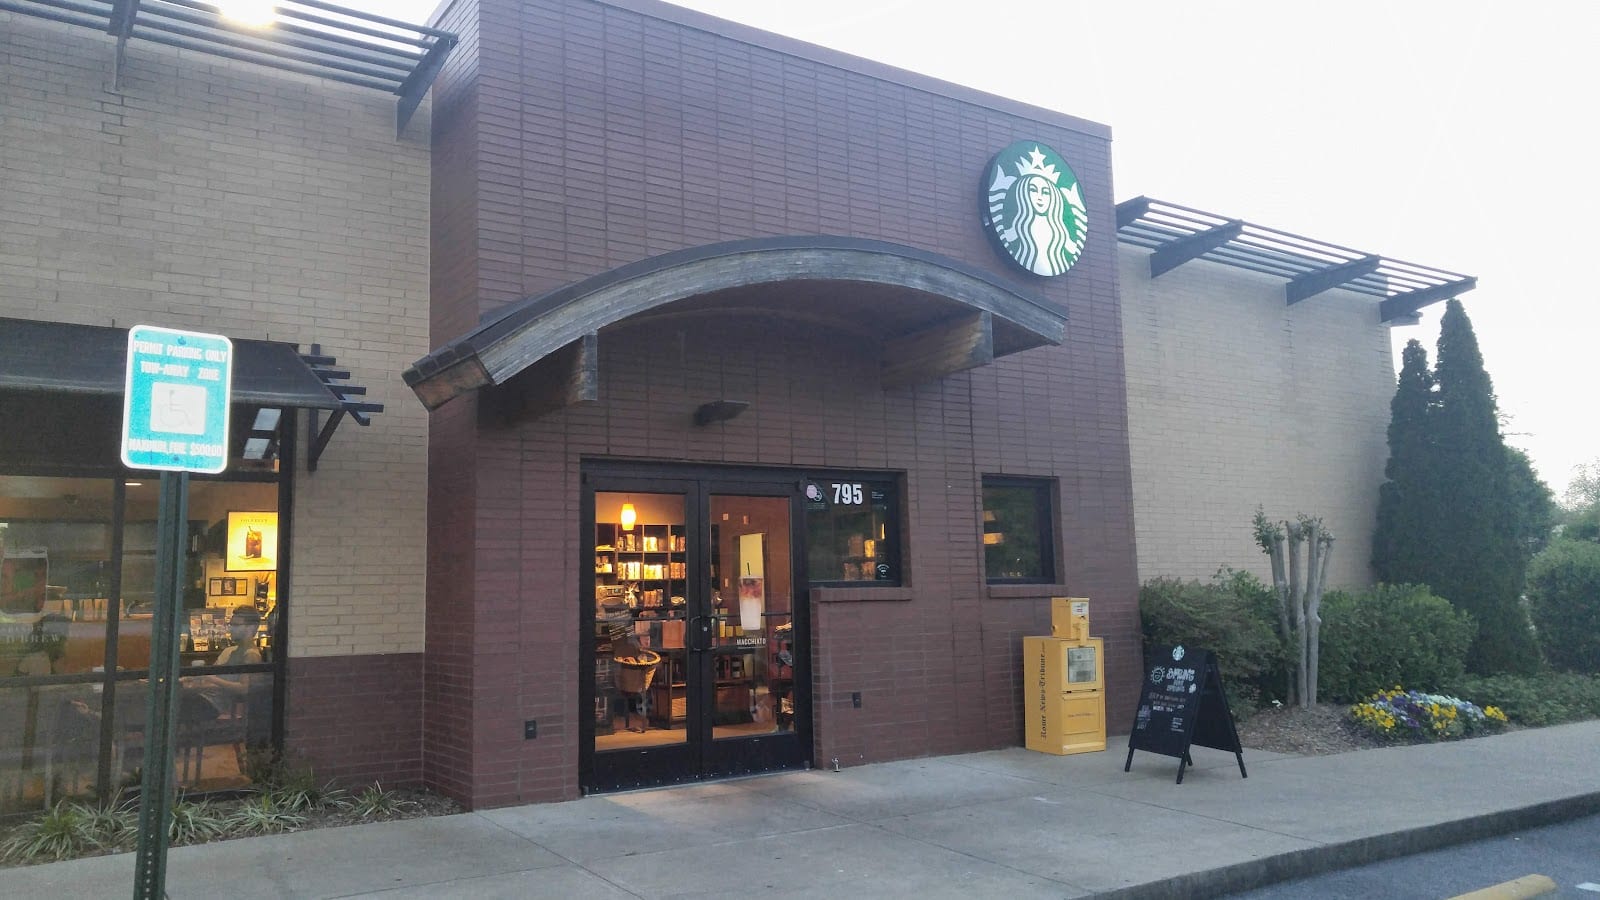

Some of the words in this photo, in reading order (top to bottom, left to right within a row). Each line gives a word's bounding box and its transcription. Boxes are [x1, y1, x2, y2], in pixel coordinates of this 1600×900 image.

[133, 341, 163, 355] PERMIT
[166, 345, 202, 360] PARKING
[205, 350, 227, 363] ONLY
[140, 361, 190, 378] TOW-AWAY
[197, 367, 220, 381] ZONE
[169, 441, 187, 455] FINE
[831, 483, 863, 505] 795
